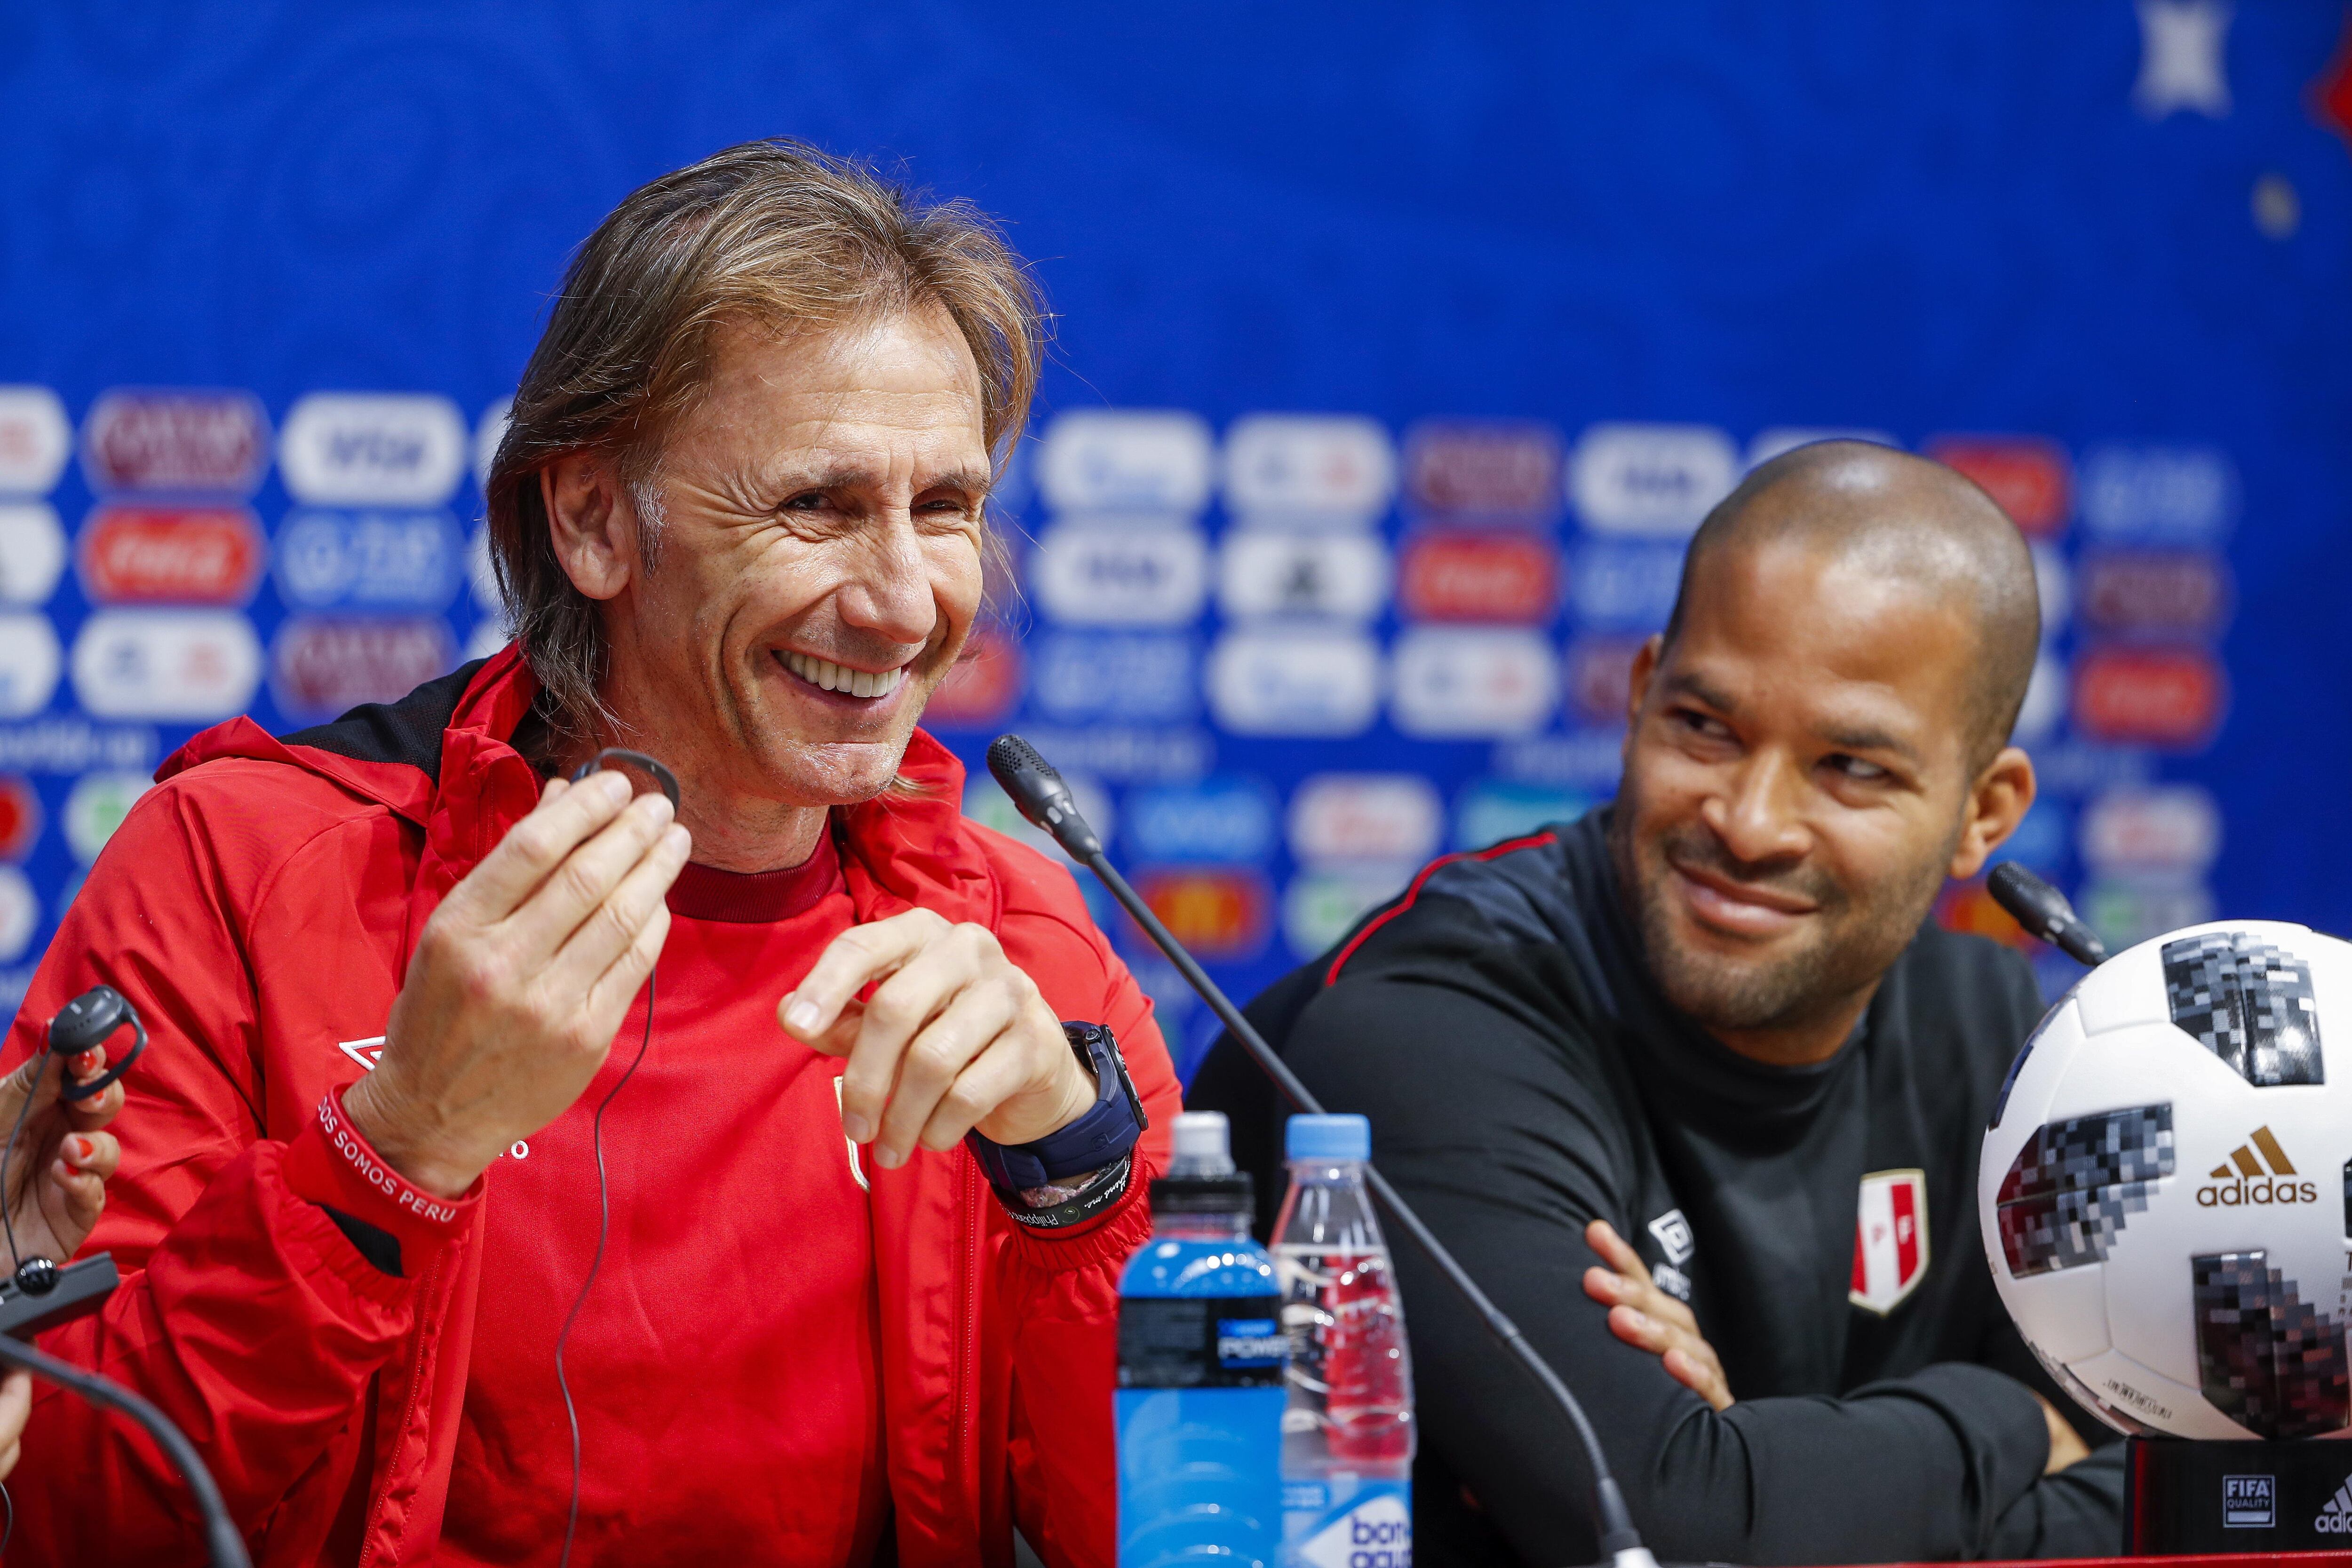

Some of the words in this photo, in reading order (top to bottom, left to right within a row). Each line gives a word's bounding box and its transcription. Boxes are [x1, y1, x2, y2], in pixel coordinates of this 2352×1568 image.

[334, 1130, 397, 1195] SOMOS
[399, 1189, 456, 1223] PERU
[2196, 1178, 2318, 1207] adidas
[2227, 1479, 2270, 1497] FIFA
[2226, 1497, 2270, 1509] QUALITY
